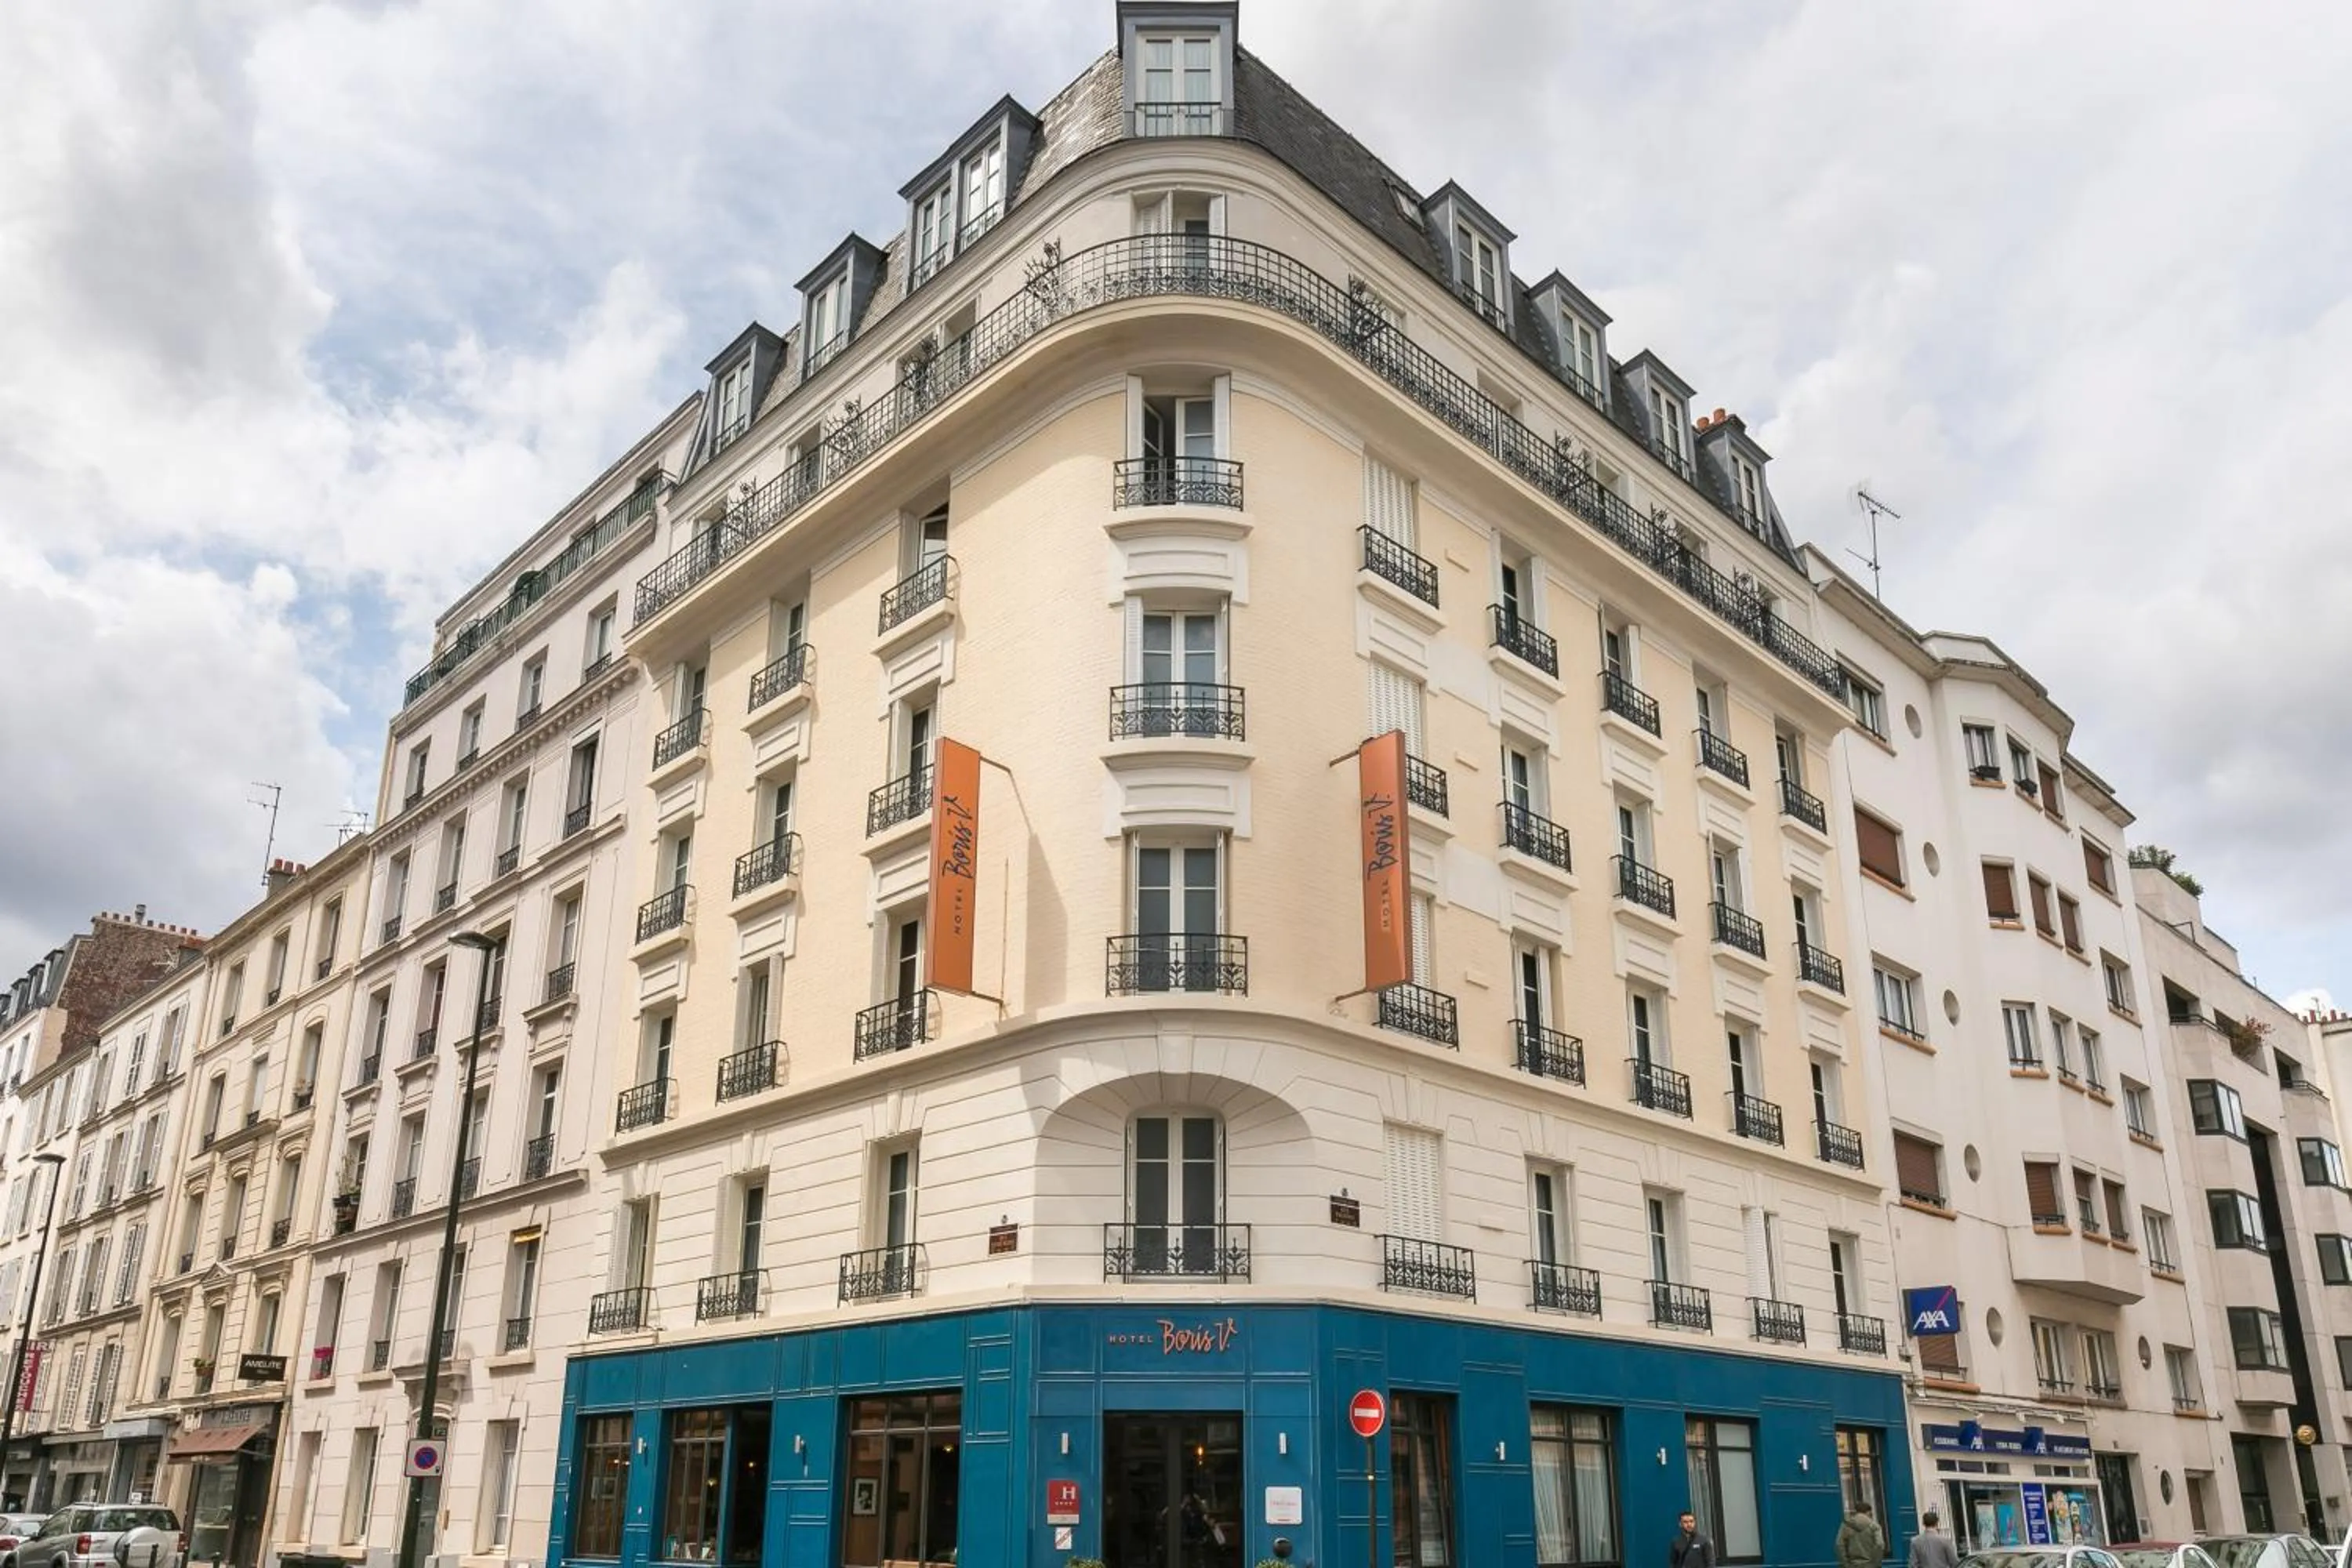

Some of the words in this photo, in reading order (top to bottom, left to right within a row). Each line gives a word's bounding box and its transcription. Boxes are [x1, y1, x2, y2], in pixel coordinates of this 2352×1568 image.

[942, 821, 974, 879] Boris
[1367, 813, 1399, 883] Boris
[953, 888, 963, 936] HOTEL
[1381, 877, 1390, 928] HOTEL
[1109, 1334, 1154, 1344] HOTEL
[1156, 1319, 1215, 1356] Boris
[1913, 1310, 1950, 1330] AXA
[1062, 1486, 1076, 1500] H
